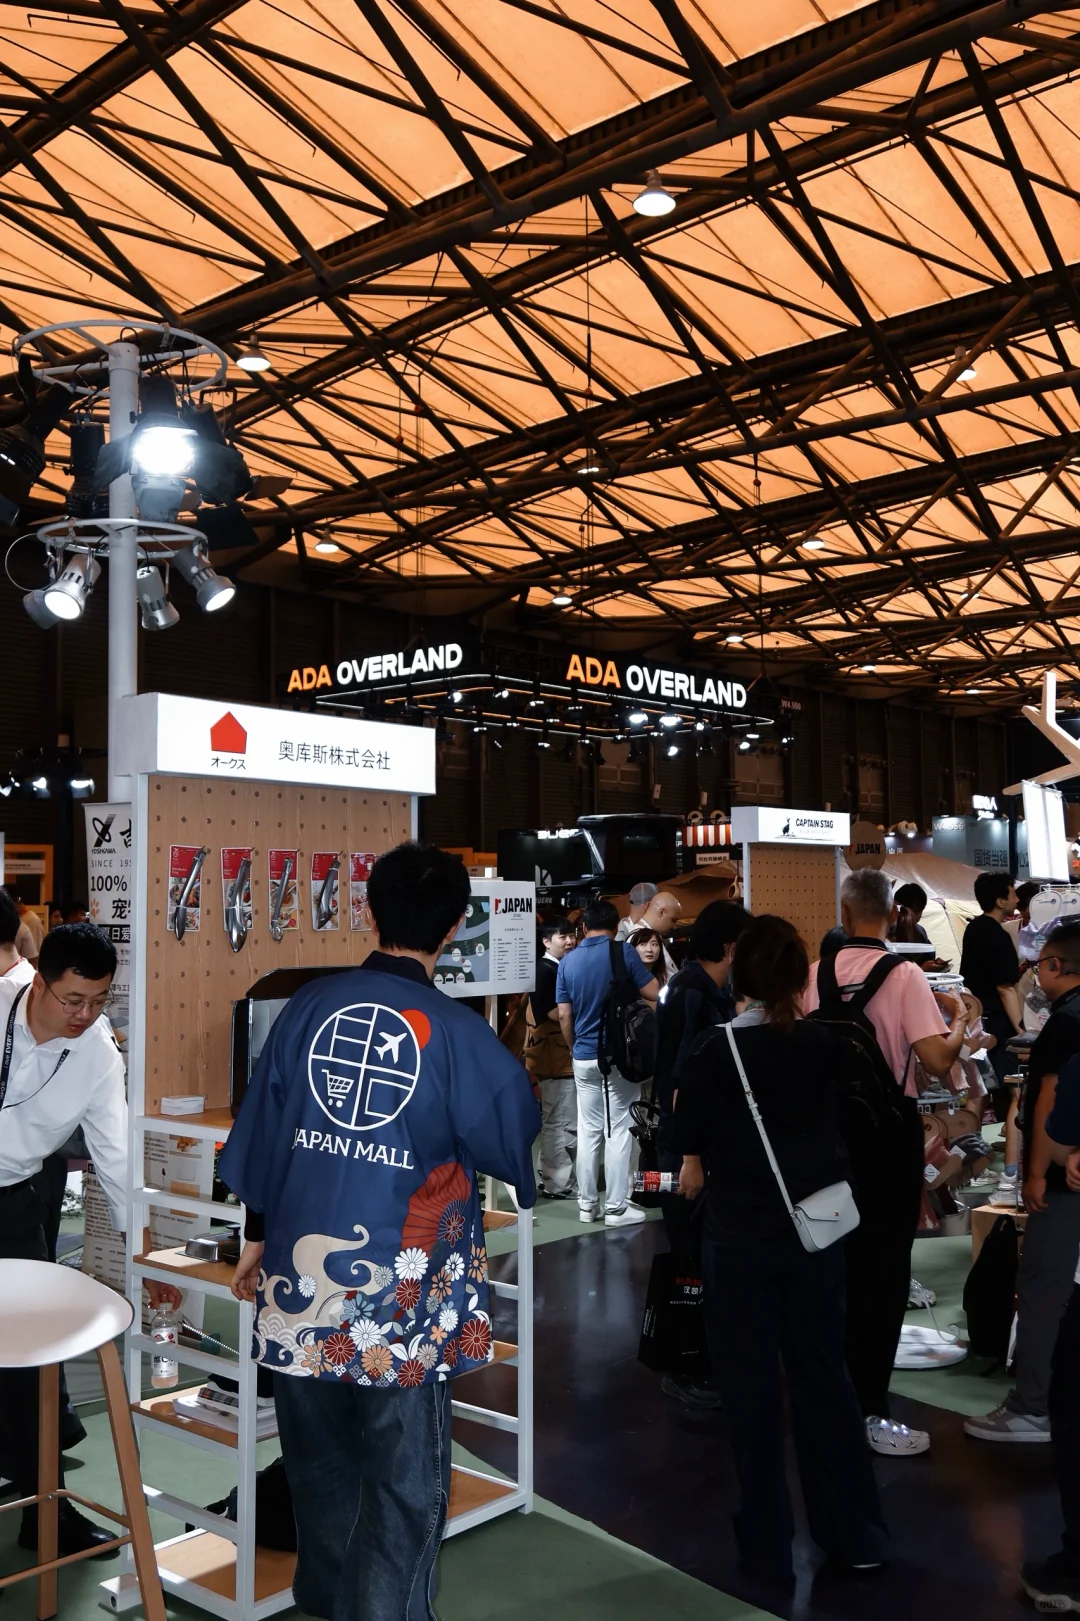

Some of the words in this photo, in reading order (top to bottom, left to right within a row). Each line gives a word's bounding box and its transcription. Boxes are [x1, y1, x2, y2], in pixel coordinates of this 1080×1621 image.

[287, 665, 332, 692] ADA
[336, 643, 463, 685] OVERLAND
[566, 653, 621, 689] ADA
[626, 665, 747, 708] OVERLAND
[210, 756, 247, 770] オークス
[278, 740, 391, 770] 奥库斯株式会社
[795, 818, 819, 828] CAPTAIN
[820, 820, 834, 829] STAG
[855, 843, 881, 855] JAPAN
[91, 859, 113, 868] SINCE
[90, 875, 127, 892] 100%
[111, 898, 131, 919] 宠
[502, 897, 533, 914] JAPAN
[4, 1034, 12, 1054] EVERY
[353, 1140, 414, 1170] MALL
